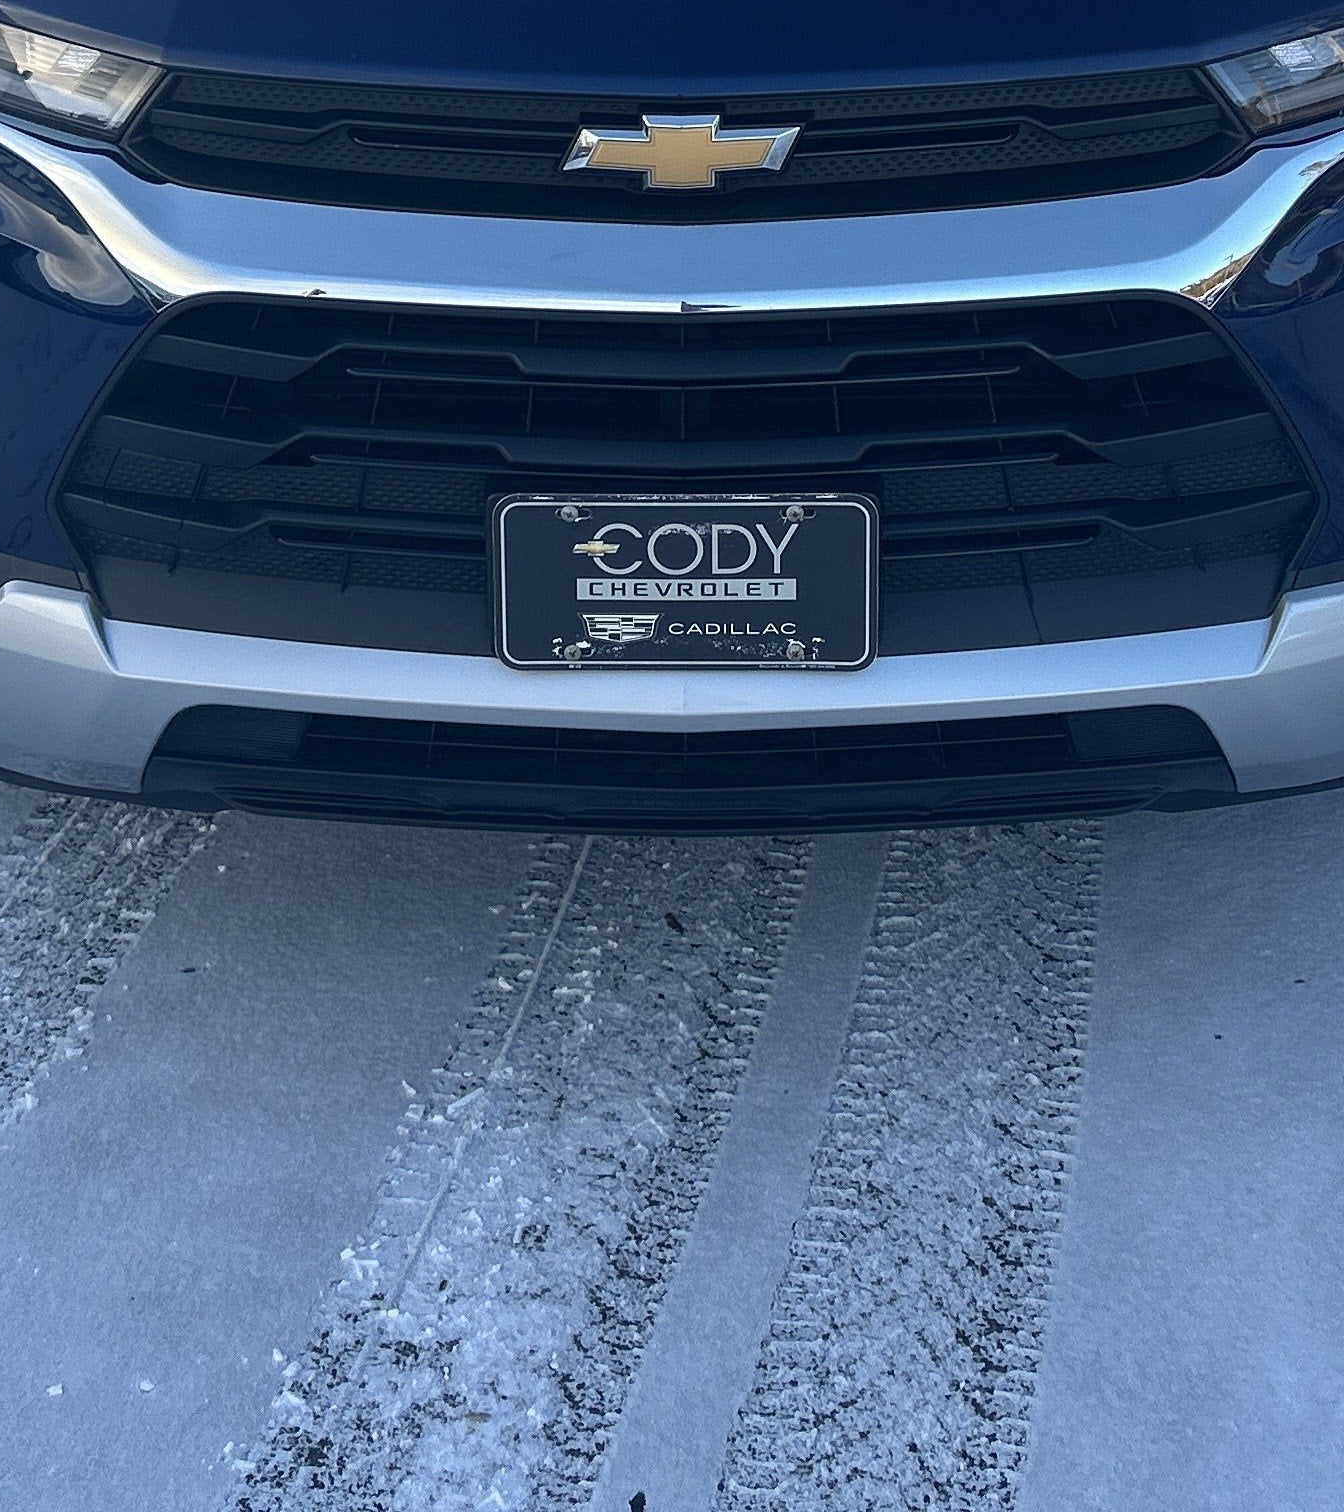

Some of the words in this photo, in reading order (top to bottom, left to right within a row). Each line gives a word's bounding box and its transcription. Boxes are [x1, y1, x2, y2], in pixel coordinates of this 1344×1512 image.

[590, 522, 799, 576] CODY
[588, 581, 785, 597] CHEVROLET
[667, 621, 797, 636] CADILLAC
